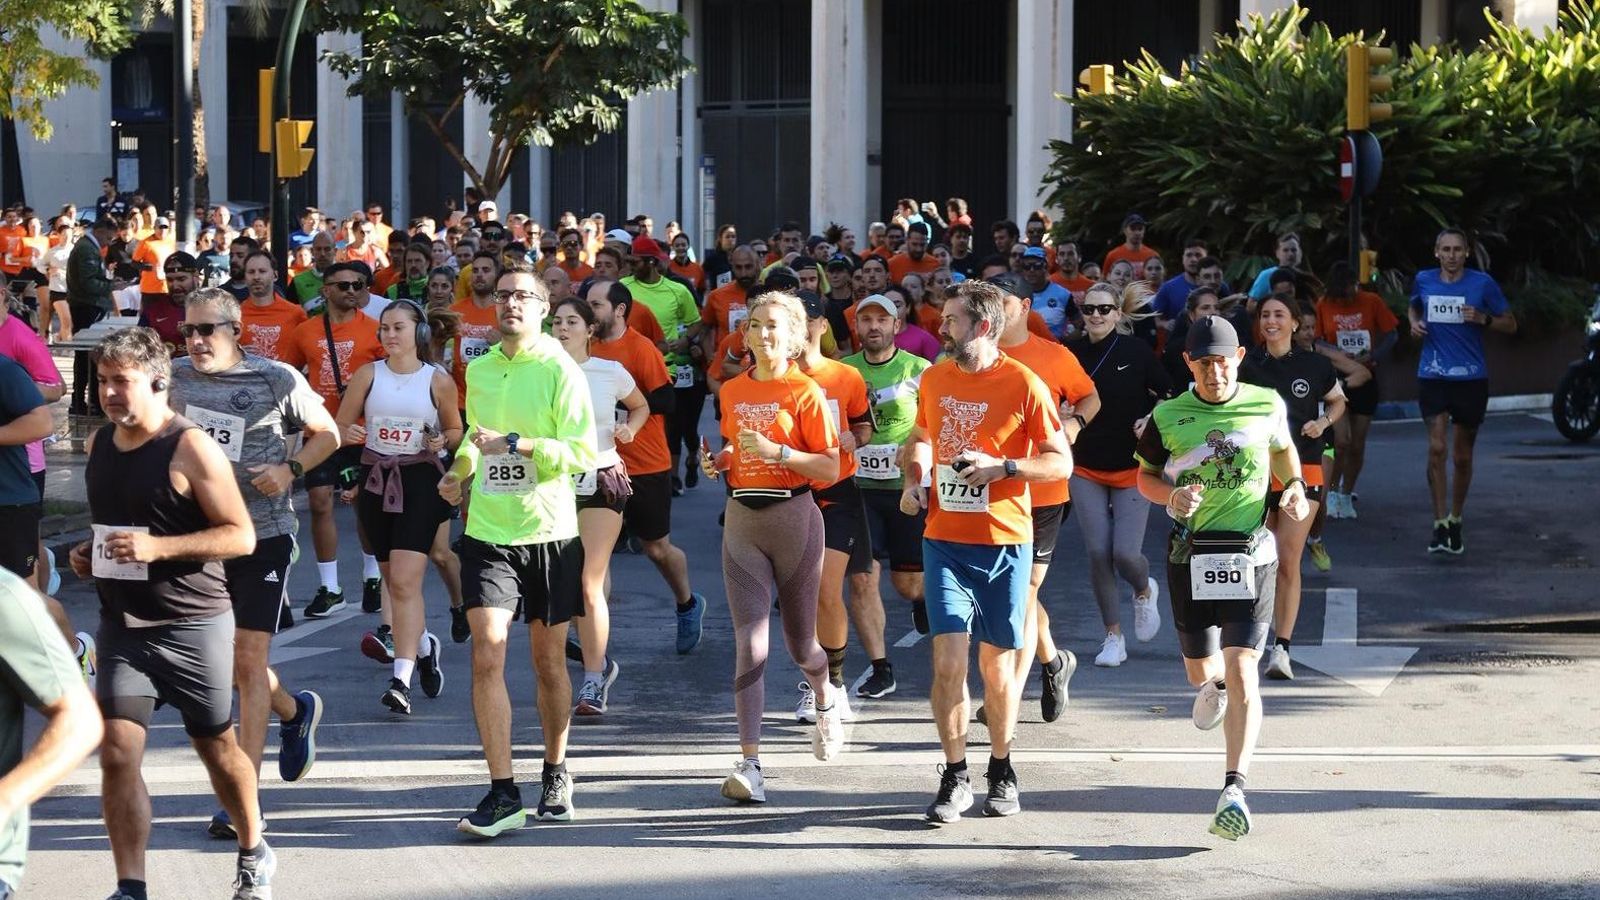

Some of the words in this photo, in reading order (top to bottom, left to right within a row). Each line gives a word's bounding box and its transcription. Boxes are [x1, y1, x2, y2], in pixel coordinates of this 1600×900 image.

[1432, 304, 1461, 314] 1011
[1342, 337, 1364, 346] 856
[197, 423, 231, 444] 13
[379, 428, 412, 442] 847
[861, 456, 890, 469] 501
[489, 465, 525, 480] 283
[1204, 570, 1241, 583] 990
